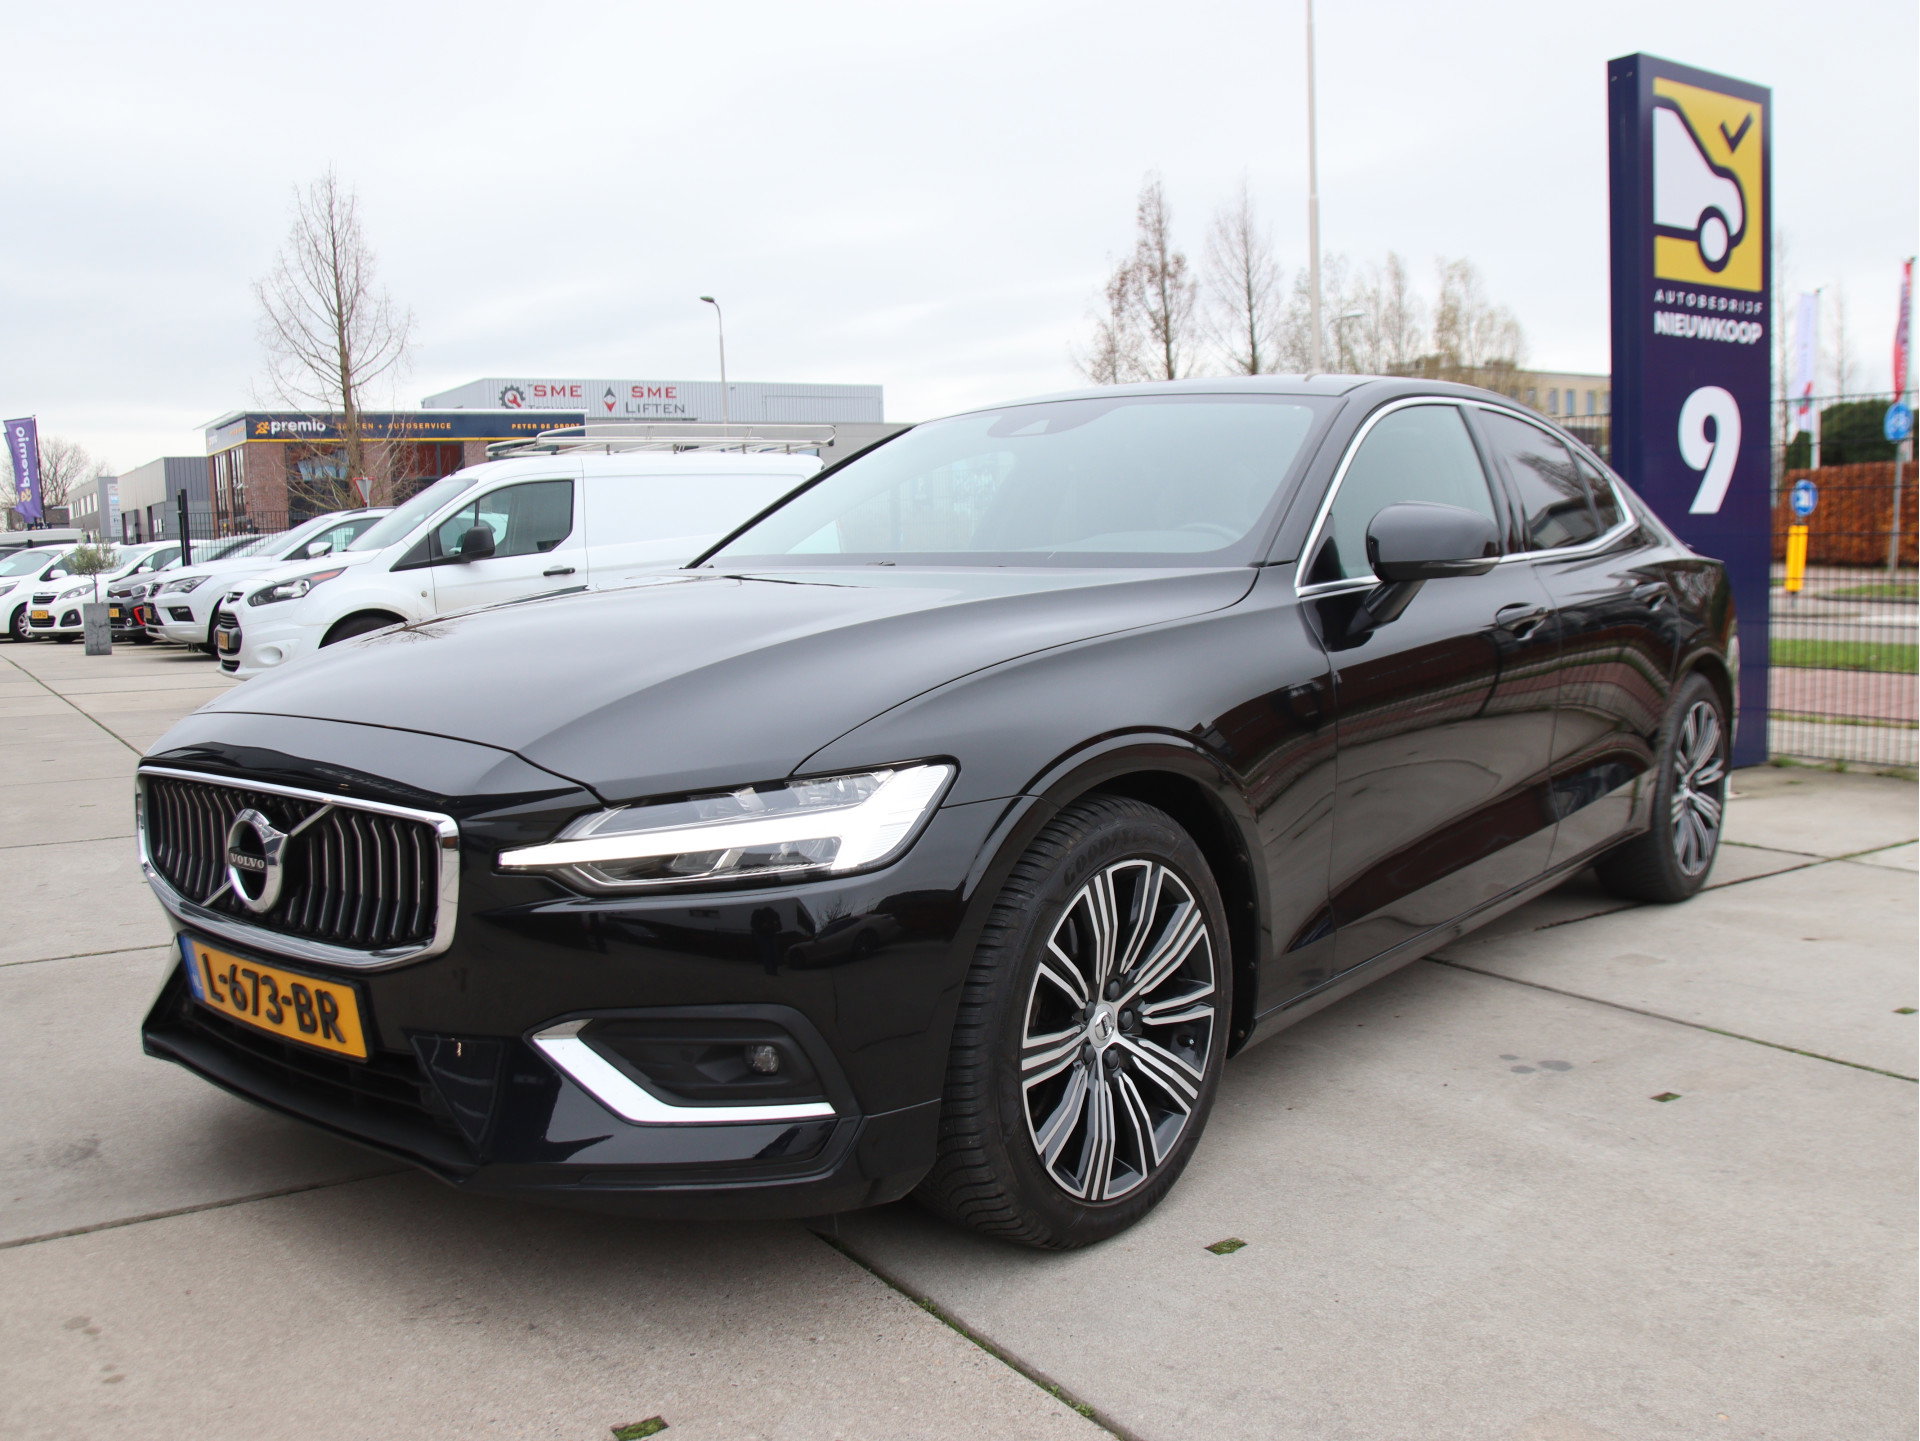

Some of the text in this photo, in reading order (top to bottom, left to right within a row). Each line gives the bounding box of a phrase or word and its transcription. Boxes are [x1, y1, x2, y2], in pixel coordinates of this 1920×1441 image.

[1654, 289, 1763, 315] AUTOBEDRIJF
[1654, 310, 1763, 345] NIEUWKOOP
[534, 385, 582, 397] SME
[631, 385, 676, 398] SME
[625, 401, 685, 413] LIFTEN
[271, 418, 326, 434] premio
[1678, 385, 1742, 514] 9
[230, 853, 265, 869] VOLVO
[201, 952, 346, 1044] L-673-BR
